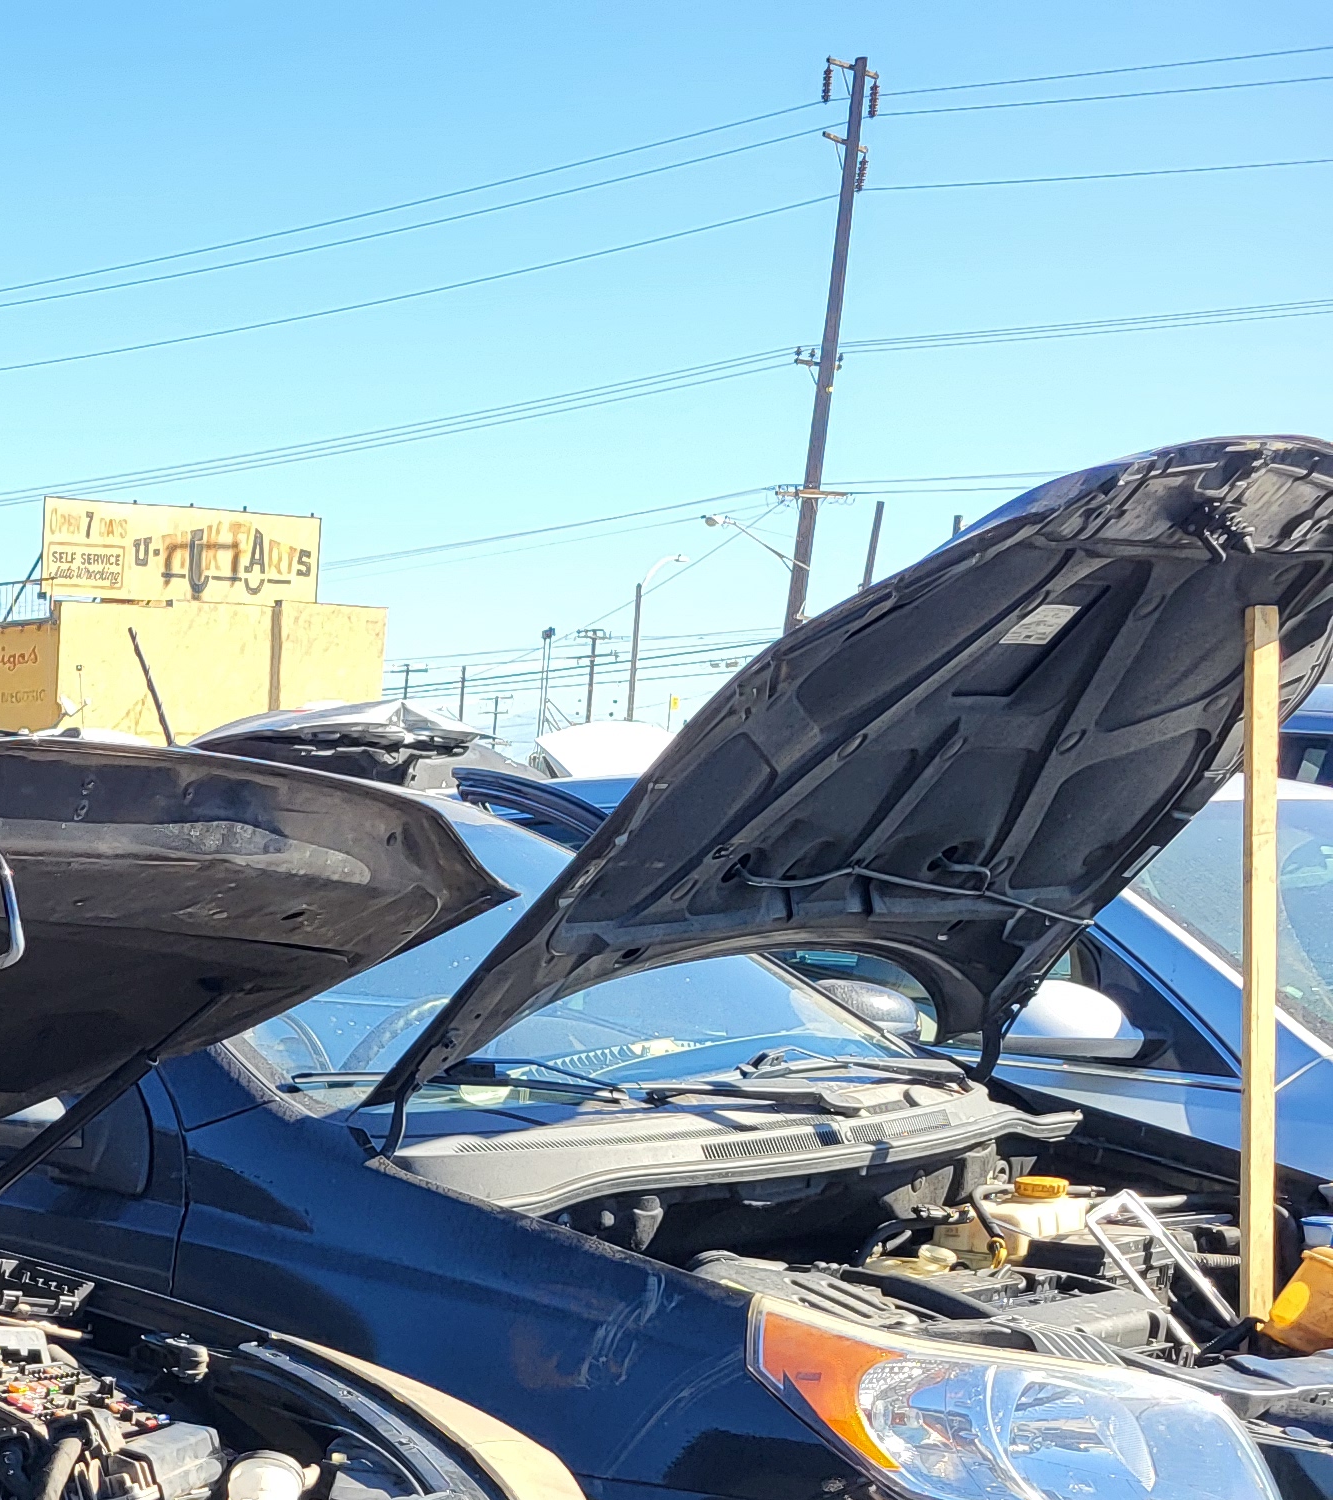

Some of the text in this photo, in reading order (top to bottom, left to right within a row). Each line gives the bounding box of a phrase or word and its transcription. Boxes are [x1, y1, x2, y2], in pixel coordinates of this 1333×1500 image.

[85, 510, 94, 539] 7
[98, 517, 128, 539] DAYS
[51, 551, 121, 566] SELF SERVICE
